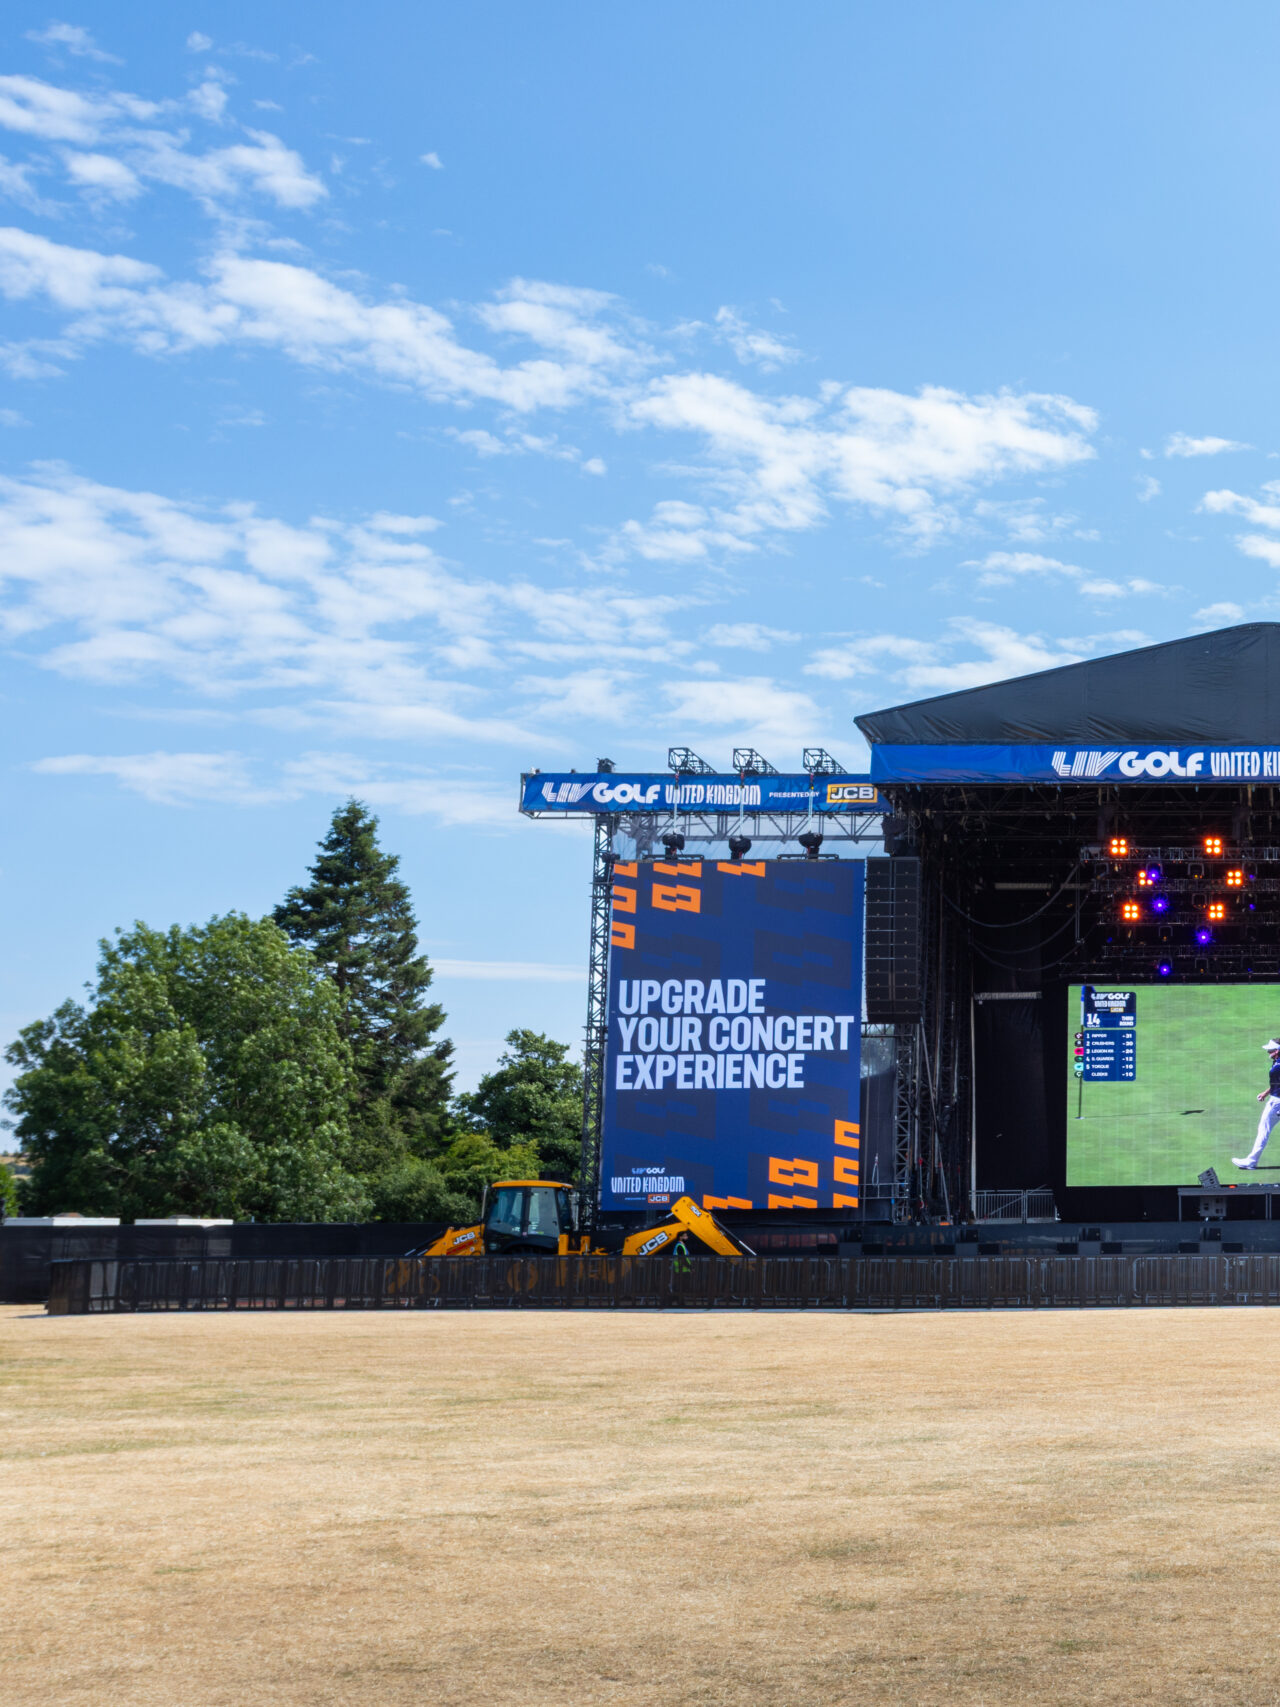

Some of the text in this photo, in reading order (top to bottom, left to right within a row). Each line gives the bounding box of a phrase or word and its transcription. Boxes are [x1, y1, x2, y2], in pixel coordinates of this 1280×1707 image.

[1051, 751, 1123, 776] LIV
[1118, 751, 1204, 777] GOLF
[1210, 751, 1260, 776] UNITED
[541, 782, 596, 802] LIV
[592, 782, 660, 804] GOLF
[665, 784, 704, 804] UNITED
[706, 784, 761, 805] KINGDOM
[831, 786, 874, 799] JCB
[618, 978, 766, 1015] UPGRADE
[1087, 1013, 1100, 1025] 14
[617, 1015, 855, 1052] YOUR CONCERT
[615, 1052, 805, 1090] EXPERIENCE
[611, 1176, 685, 1193] UNITED KINGDOM
[453, 1231, 476, 1245] JCB
[638, 1231, 669, 1255] JCB
